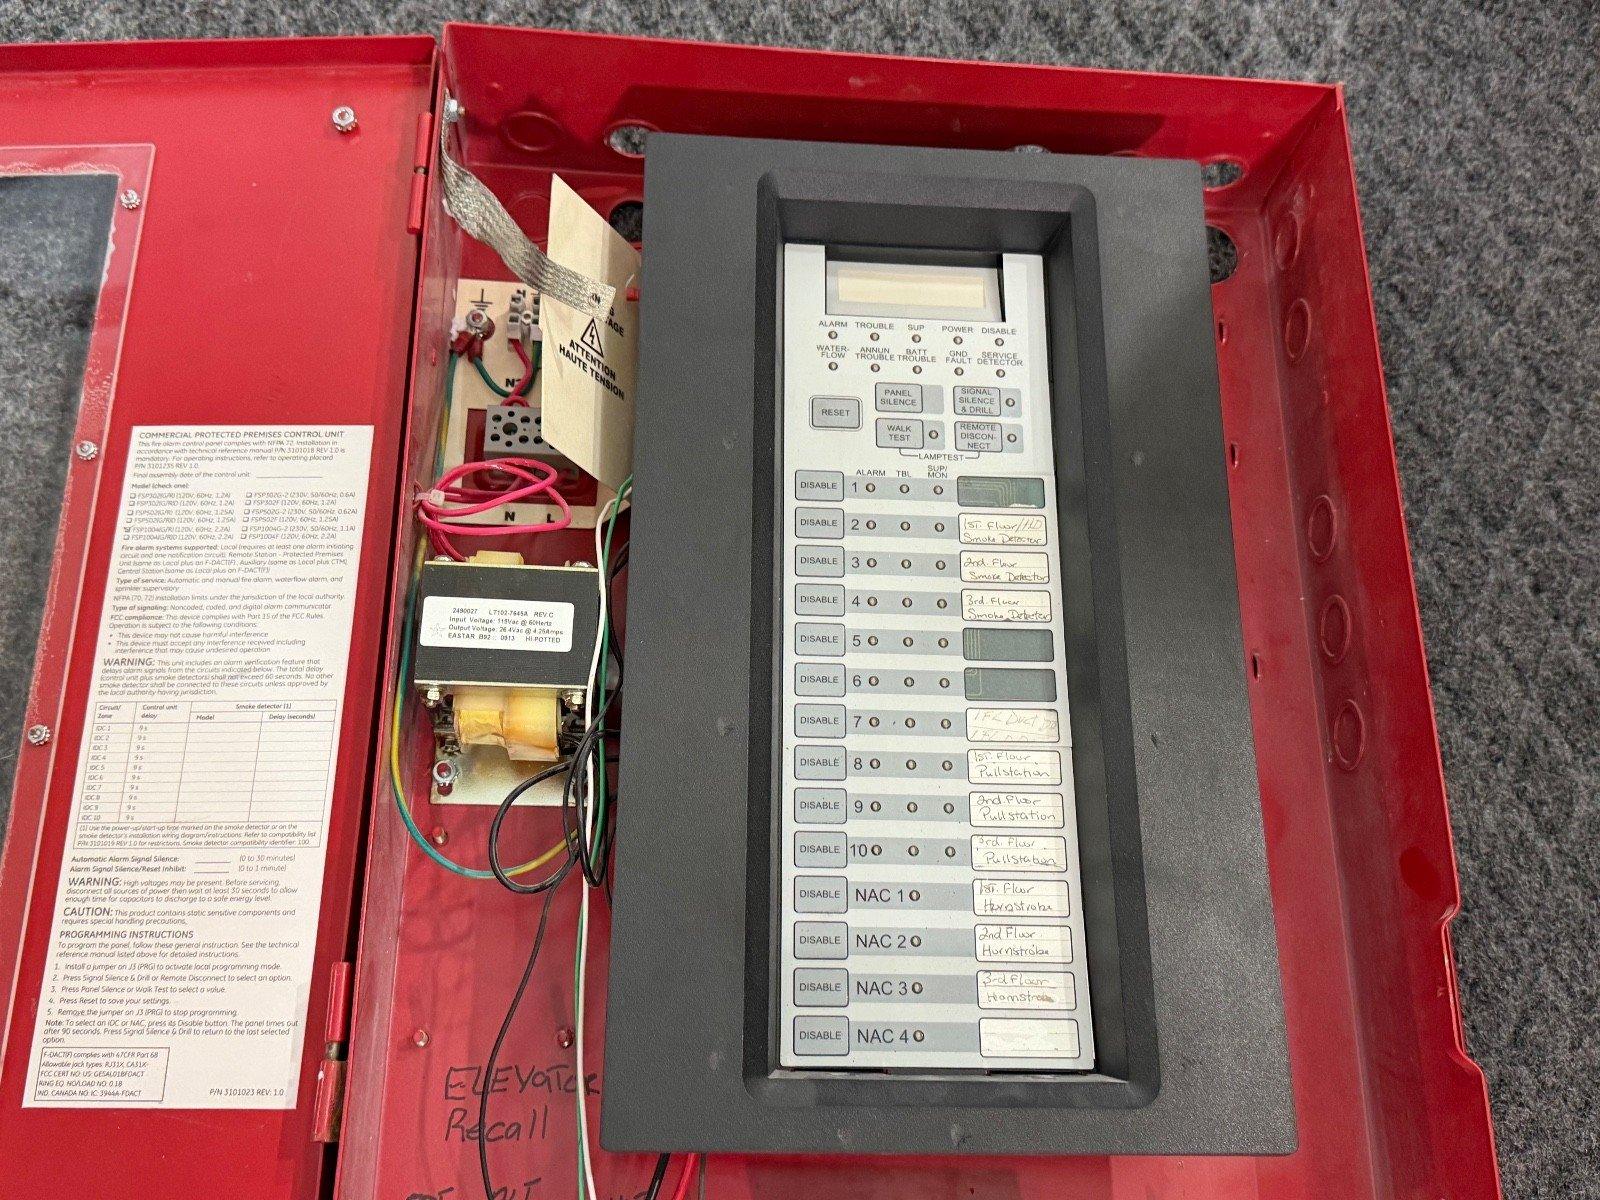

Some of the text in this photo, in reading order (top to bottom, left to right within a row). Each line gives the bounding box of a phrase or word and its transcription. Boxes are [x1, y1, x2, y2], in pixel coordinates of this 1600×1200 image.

[569, 340, 616, 380] ATTENTION
[560, 344, 624, 400] HAUTE TENSION
[821, 409, 850, 417] RESET
[852, 482, 857, 492] 1
[505, 511, 515, 521] N
[851, 520, 859, 530] 2
[964, 533, 996, 542] Smoke
[801, 557, 837, 565] DISABLE
[852, 557, 860, 568] 3
[969, 571, 1001, 580] Smoke
[852, 596, 860, 606] 4
[968, 608, 1003, 619] Smoke
[800, 634, 838, 643] DISABLE
[853, 636, 861, 646] 5
[104, 658, 155, 666] WARNING:
[800, 675, 838, 683] DISABLE
[853, 676, 861, 687] 6
[800, 716, 839, 725] DISABLE
[854, 716, 862, 728] 7
[800, 758, 839, 767] DISABLE
[854, 758, 862, 770] 8
[800, 802, 839, 810] DISABLE
[854, 801, 863, 813] 9
[800, 845, 840, 854] DISABLE
[850, 844, 867, 857] 10
[68, 877, 122, 887] WARNING:
[800, 890, 840, 898] DISABLE
[856, 889, 904, 902] NAC 1
[63, 907, 113, 917] CAUTION:
[60, 930, 194, 939] PROGRAMMING INSTRUCTIONS
[800, 936, 841, 944] DISABLE
[856, 935, 906, 948] NAC 2
[800, 983, 841, 992] DISABLE
[856, 982, 908, 995] NAC 3
[800, 1031, 842, 1040] DISABLE
[858, 1029, 908, 1043] NAC 4
[445, 1105, 548, 1142] Recall
